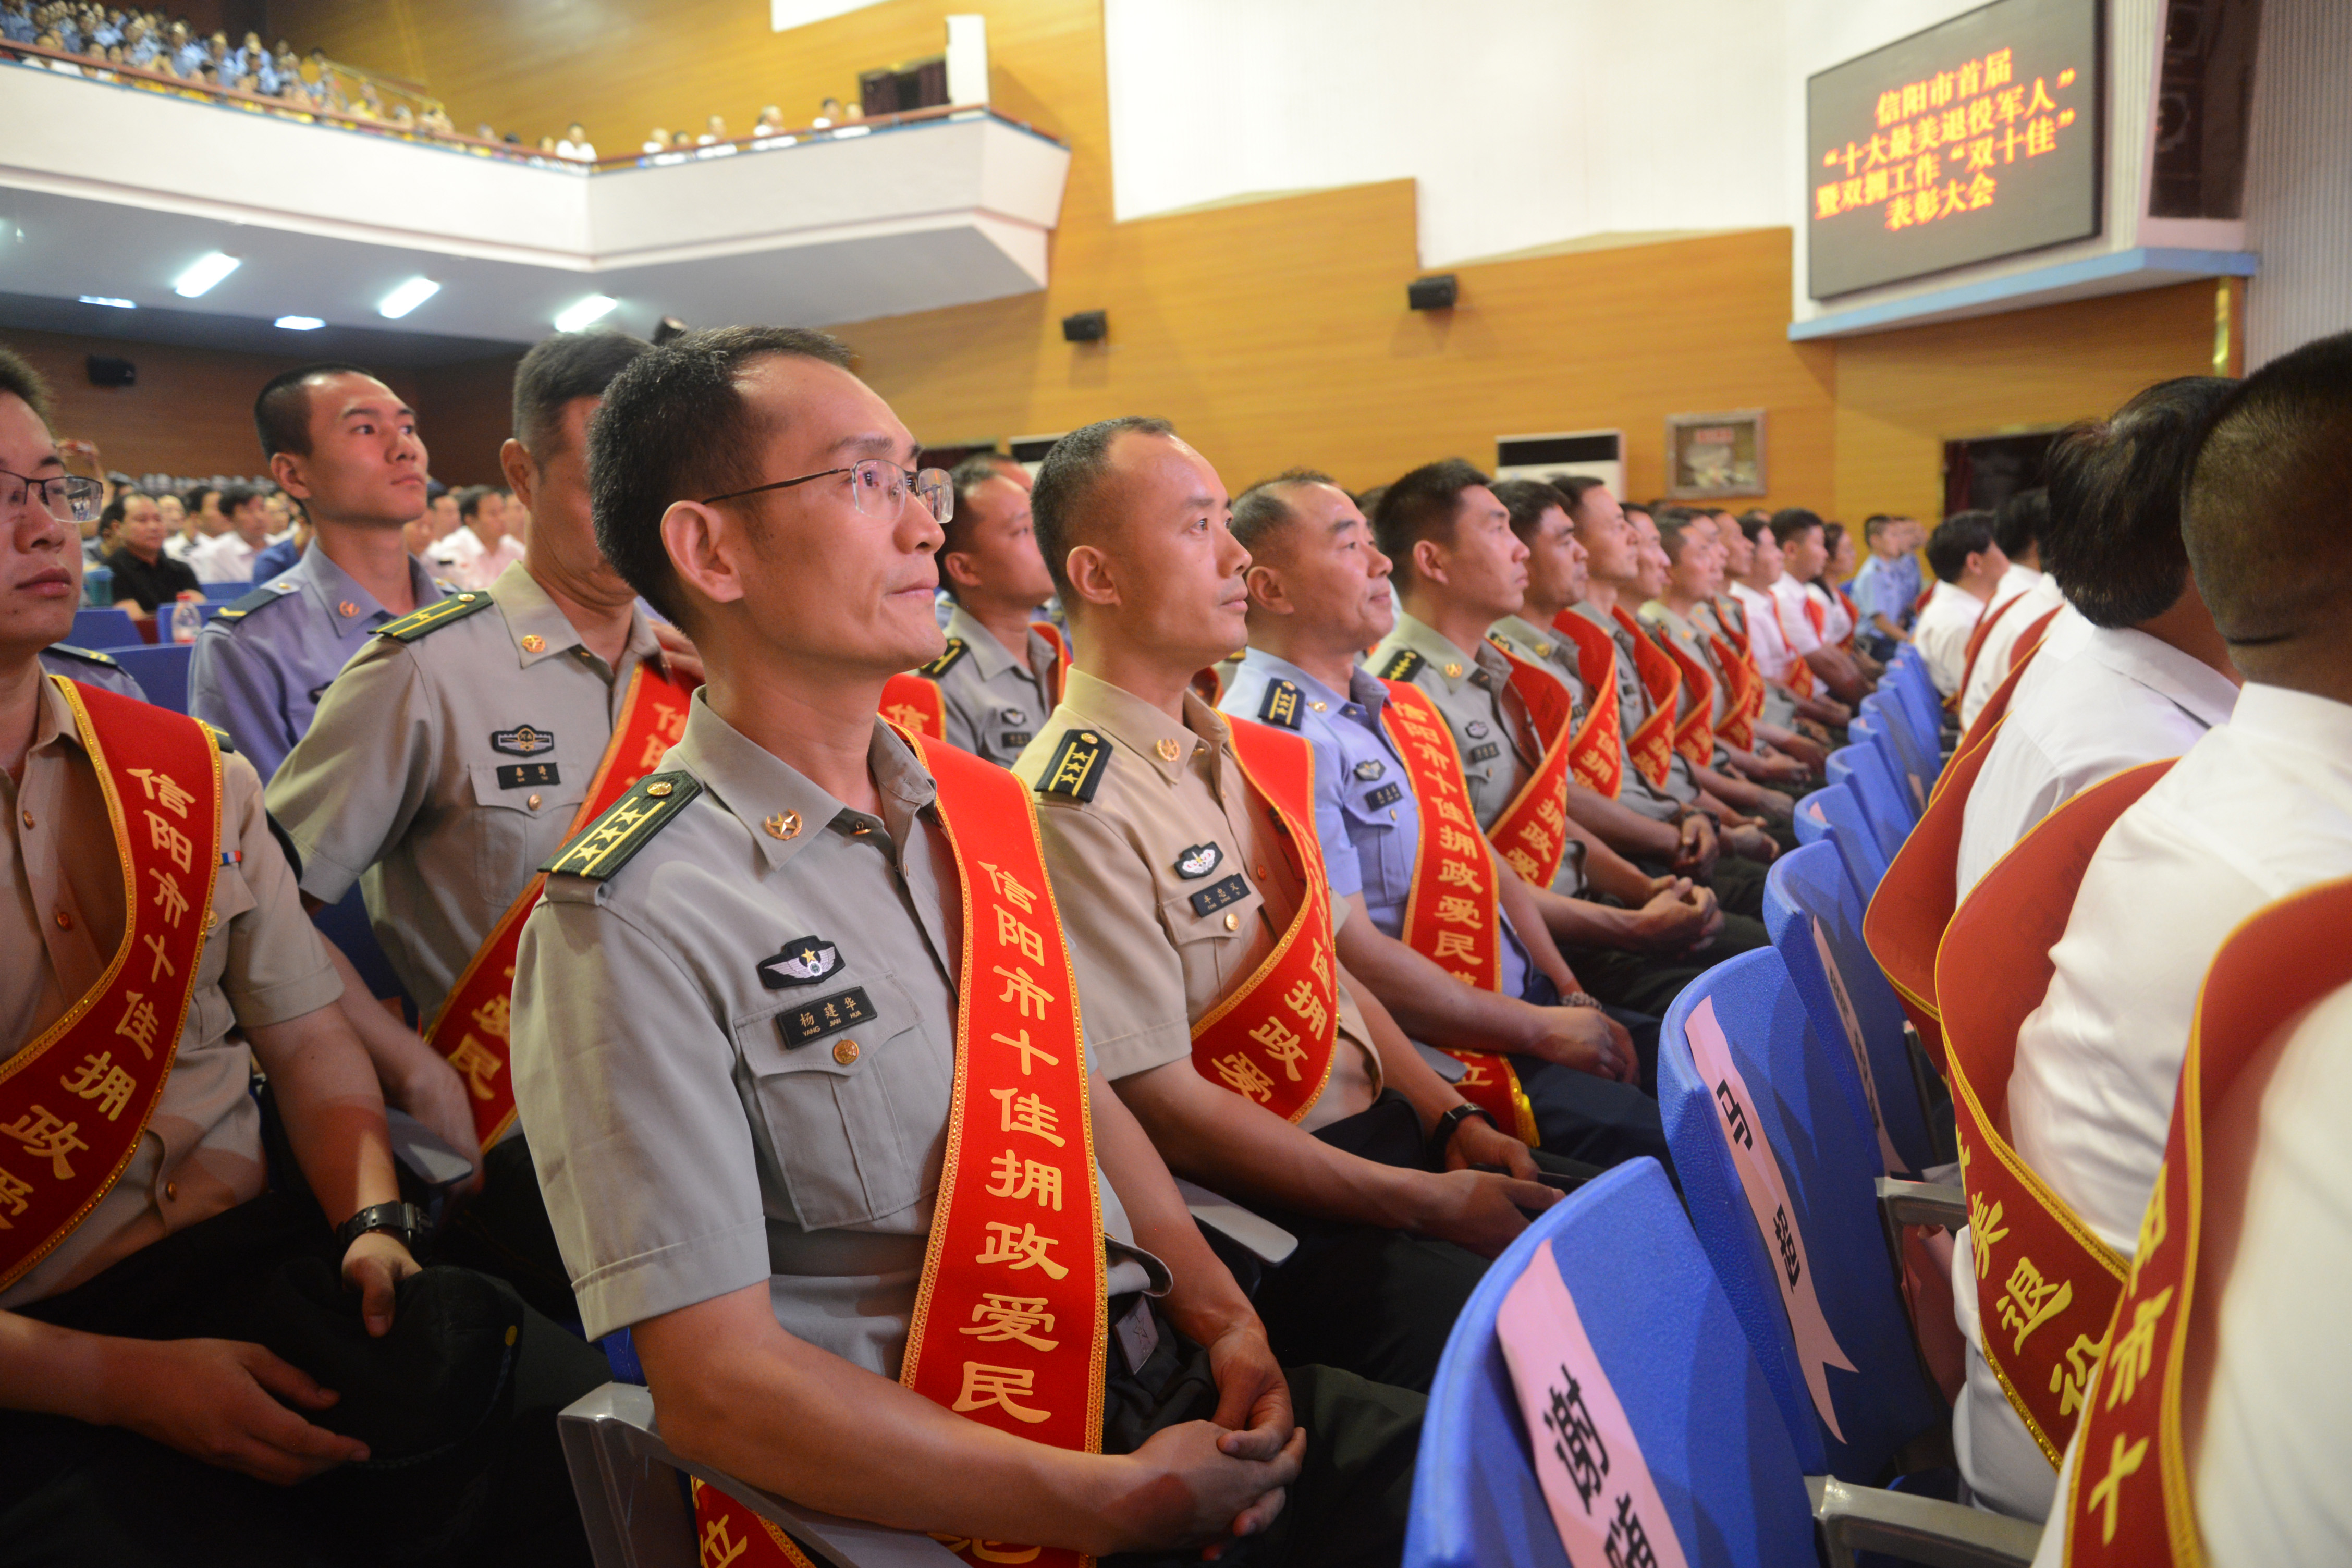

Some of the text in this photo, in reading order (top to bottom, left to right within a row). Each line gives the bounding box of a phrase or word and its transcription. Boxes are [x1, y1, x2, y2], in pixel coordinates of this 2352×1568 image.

[1875, 47, 2012, 128] 信阳市首届
[1885, 171, 1997, 231] 表彰大会
[1392, 701, 1484, 986] 信阳市十佳拥政爱民
[800, 996, 857, 1027] 杨建华
[802, 1010, 862, 1037] YANG JIAN HUA
[952, 860, 1069, 1424] 信阳市十佳拥政爱民
[1716, 1078, 1801, 1295] 马超
